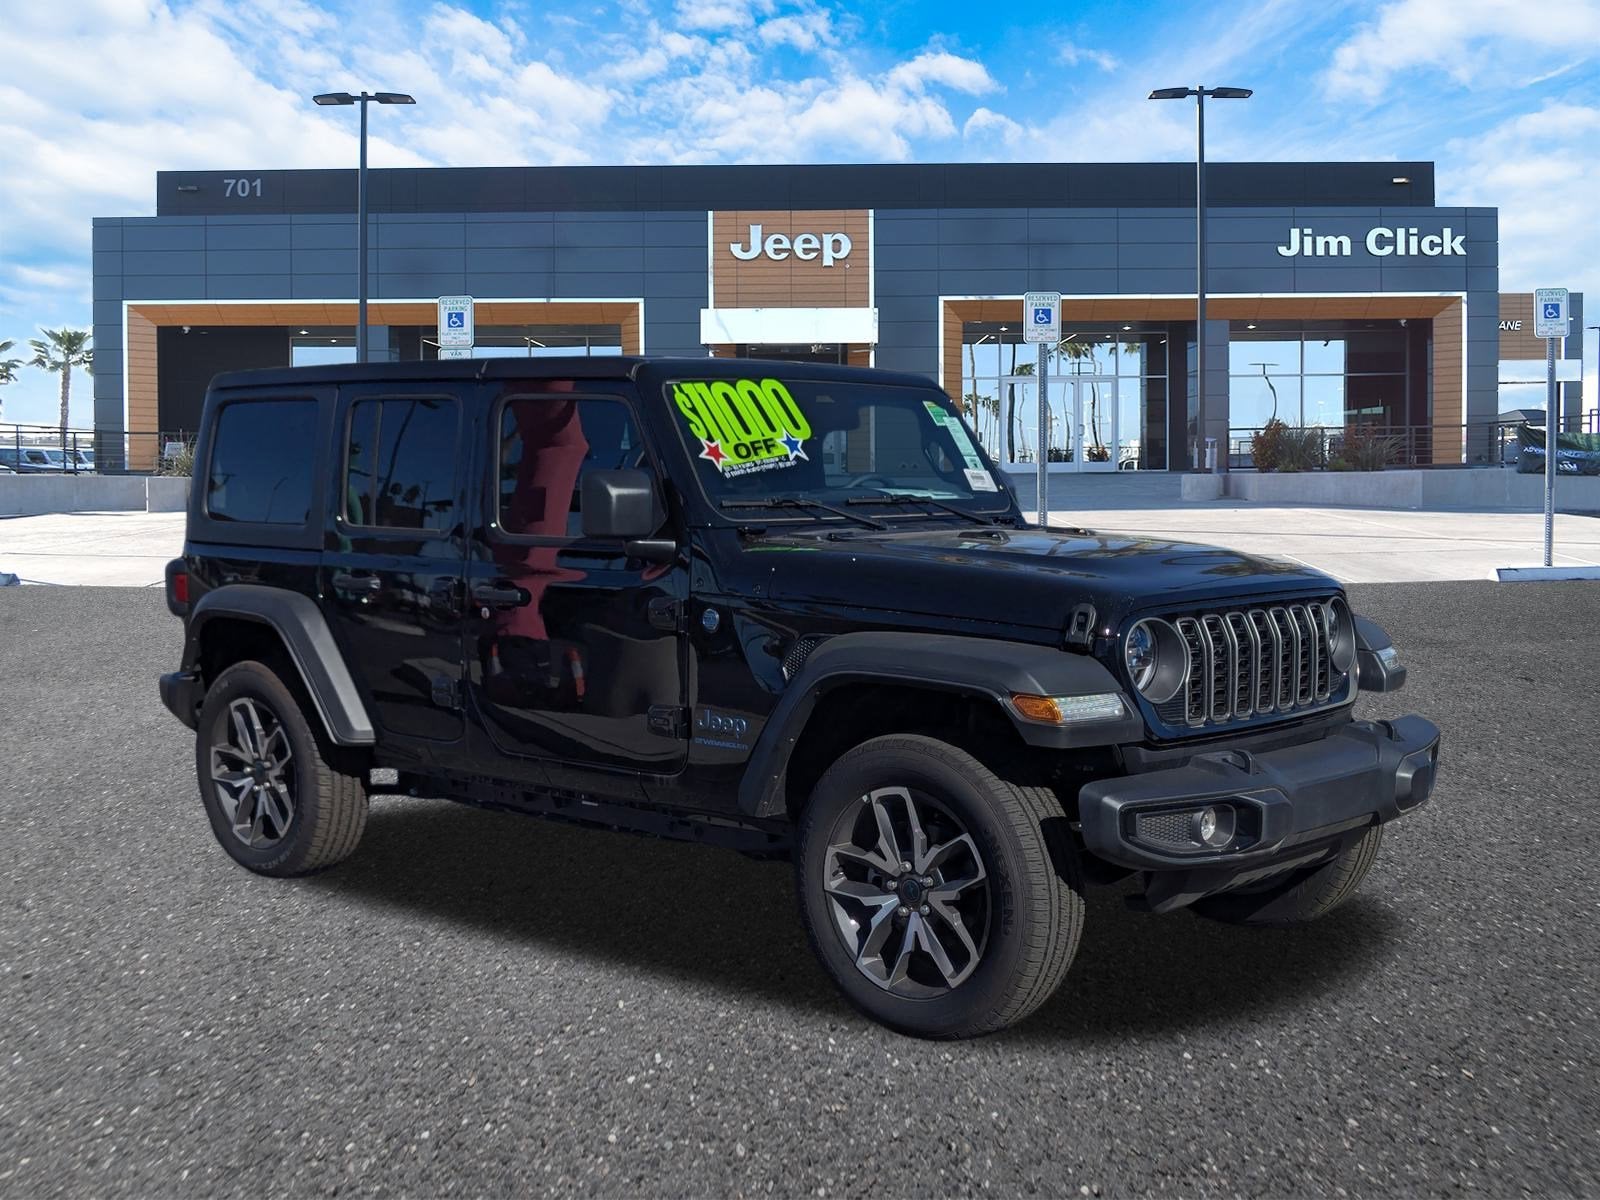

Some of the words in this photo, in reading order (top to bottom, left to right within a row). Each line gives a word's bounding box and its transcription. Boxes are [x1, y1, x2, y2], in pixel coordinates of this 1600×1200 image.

[223, 178, 261, 197] 701
[730, 224, 852, 267] Jeep
[1277, 228, 1351, 257] Jim
[1366, 227, 1467, 256] Click
[1498, 320, 1521, 330] ANE
[733, 437, 776, 460] OFF
[696, 708, 747, 739] Jeep
